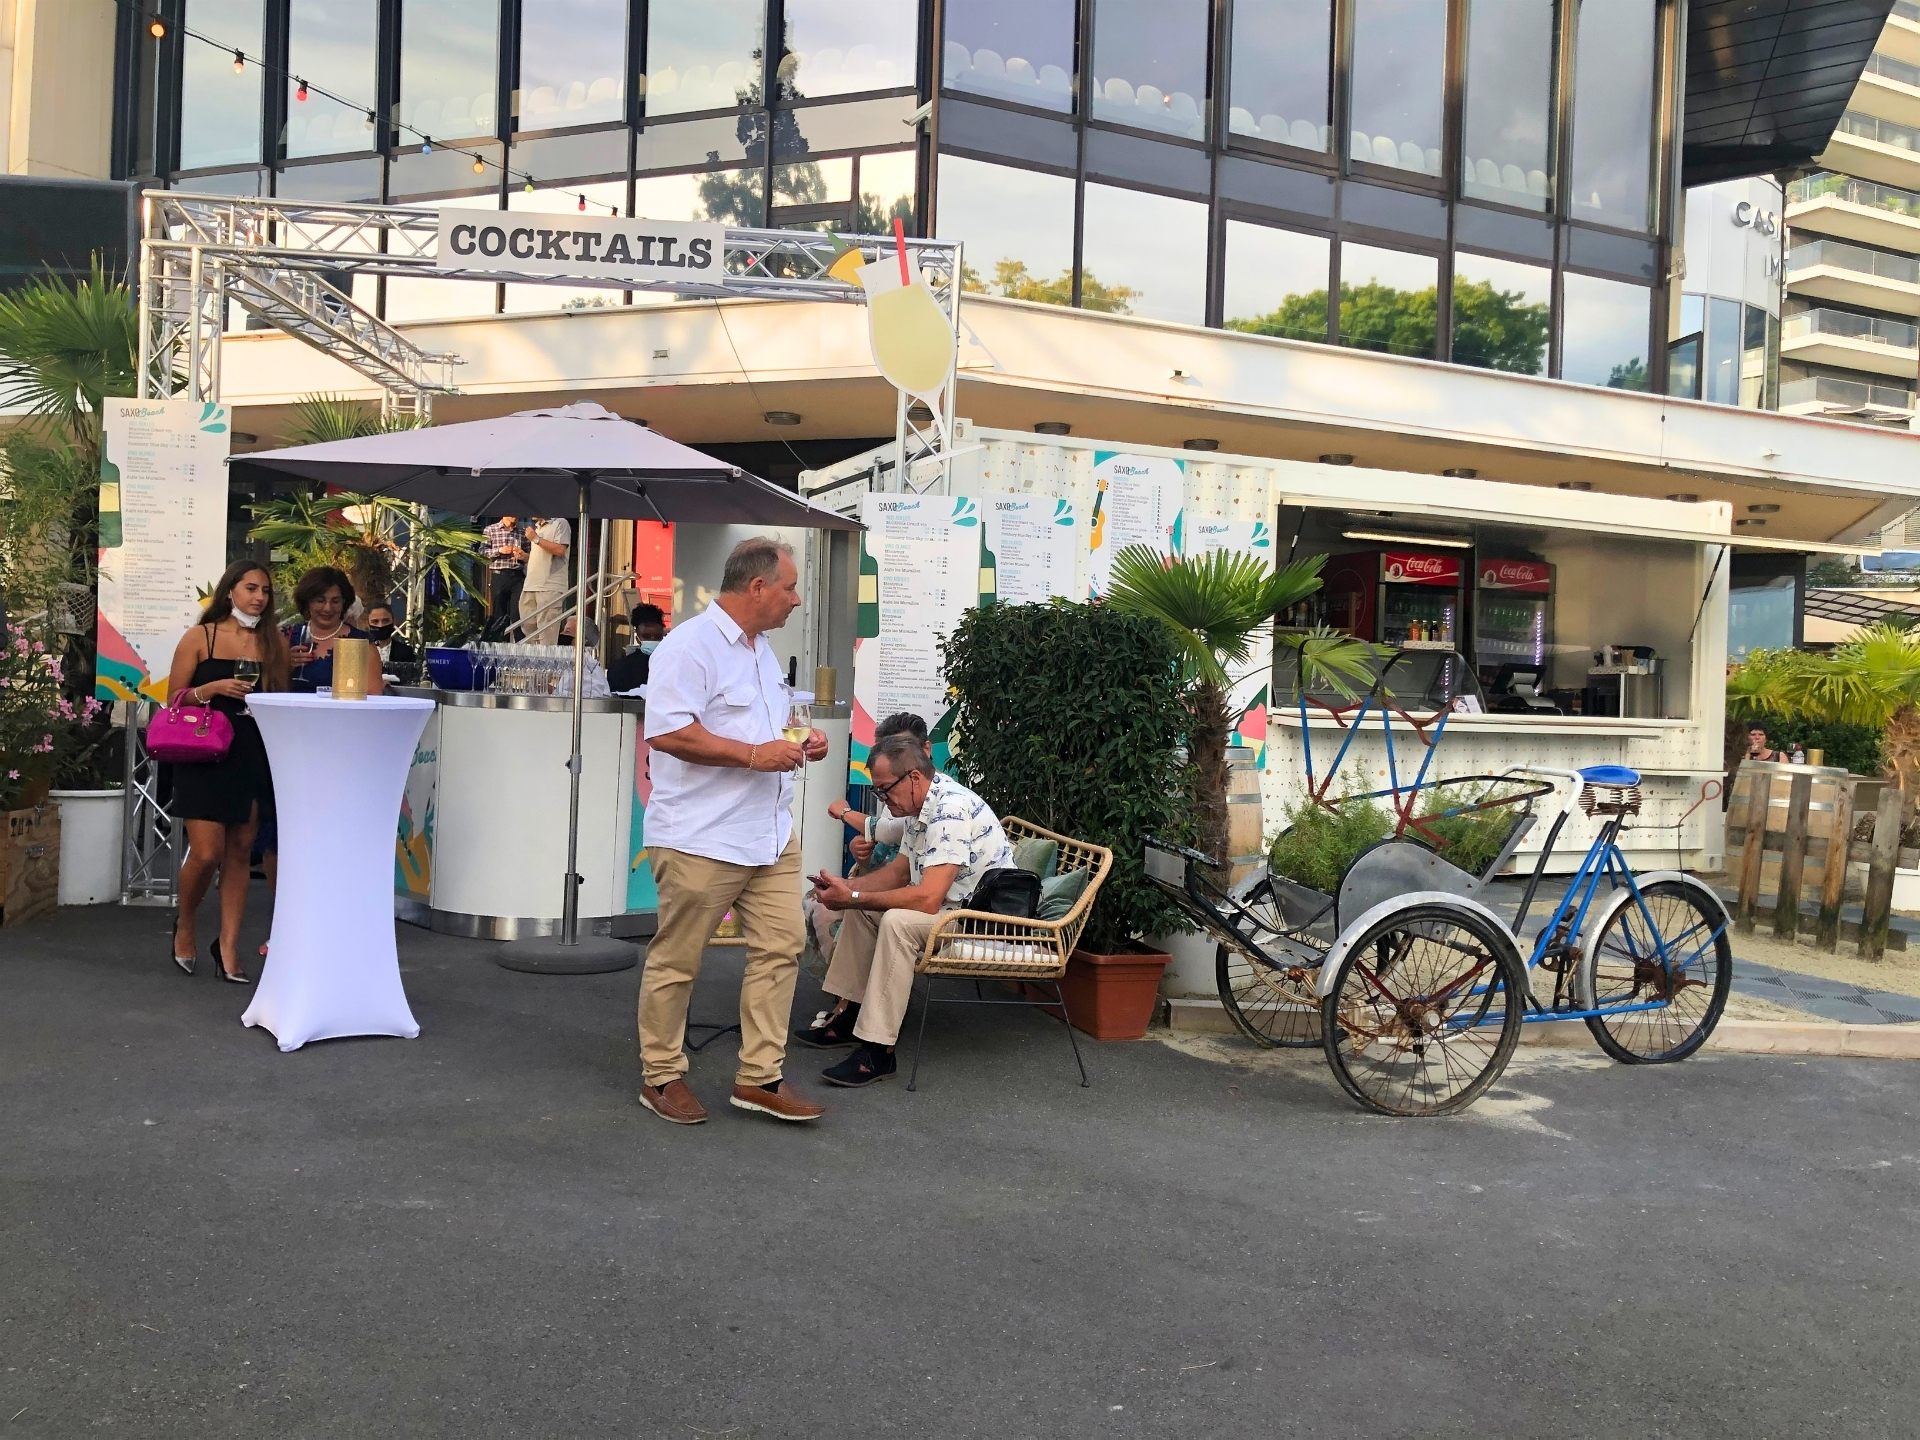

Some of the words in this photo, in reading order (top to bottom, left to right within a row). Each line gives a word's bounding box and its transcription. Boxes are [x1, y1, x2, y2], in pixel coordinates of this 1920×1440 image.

[450, 224, 712, 270] COCKTAILS
[121, 408, 140, 417] SAXO
[1114, 465, 1130, 475] SAXO
[878, 502, 897, 512] SAXO
[896, 501, 920, 511] Beach
